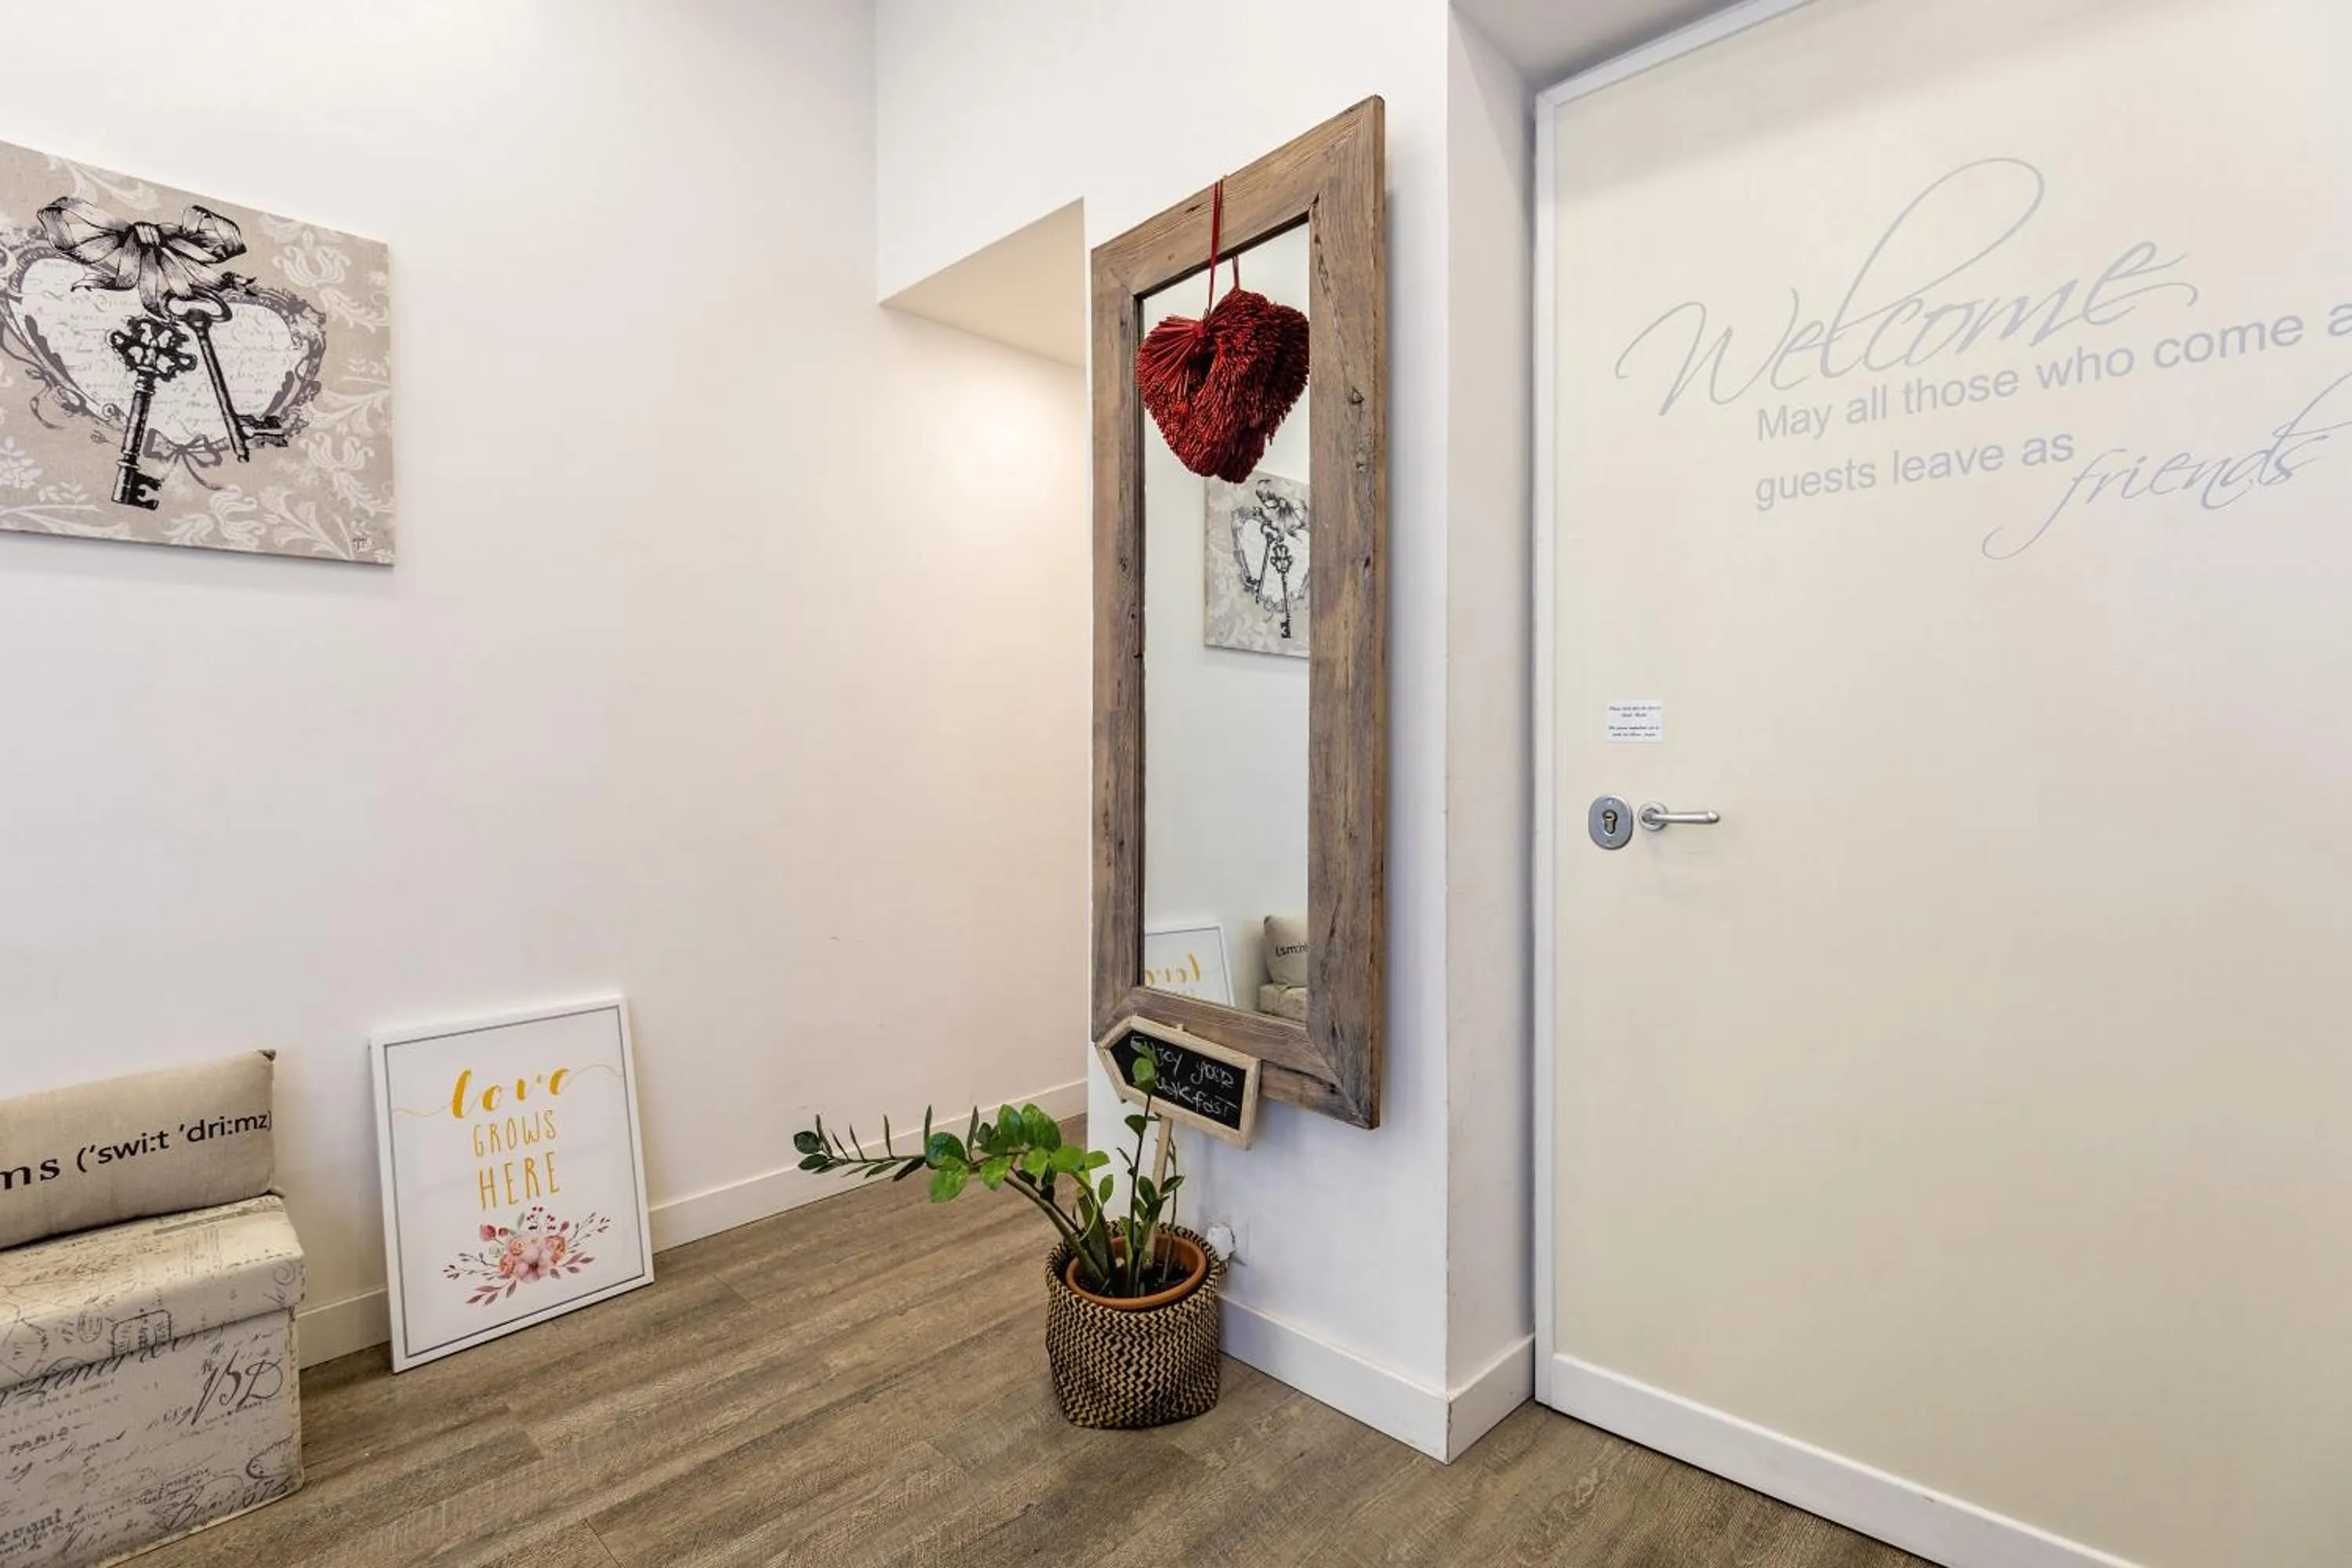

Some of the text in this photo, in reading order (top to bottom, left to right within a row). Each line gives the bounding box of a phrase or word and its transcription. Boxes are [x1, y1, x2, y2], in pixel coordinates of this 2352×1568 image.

[1615, 157, 2198, 417] Welcome
[1756, 403, 1834, 441] May
[1846, 383, 1887, 425] all
[1903, 368, 2020, 415] those
[2035, 345, 2135, 390] who
[2153, 314, 2304, 369] come
[1755, 372, 2352, 560] guests leave as friends
[472, 1109, 557, 1158] GROWS
[479, 1151, 561, 1210] HERE
